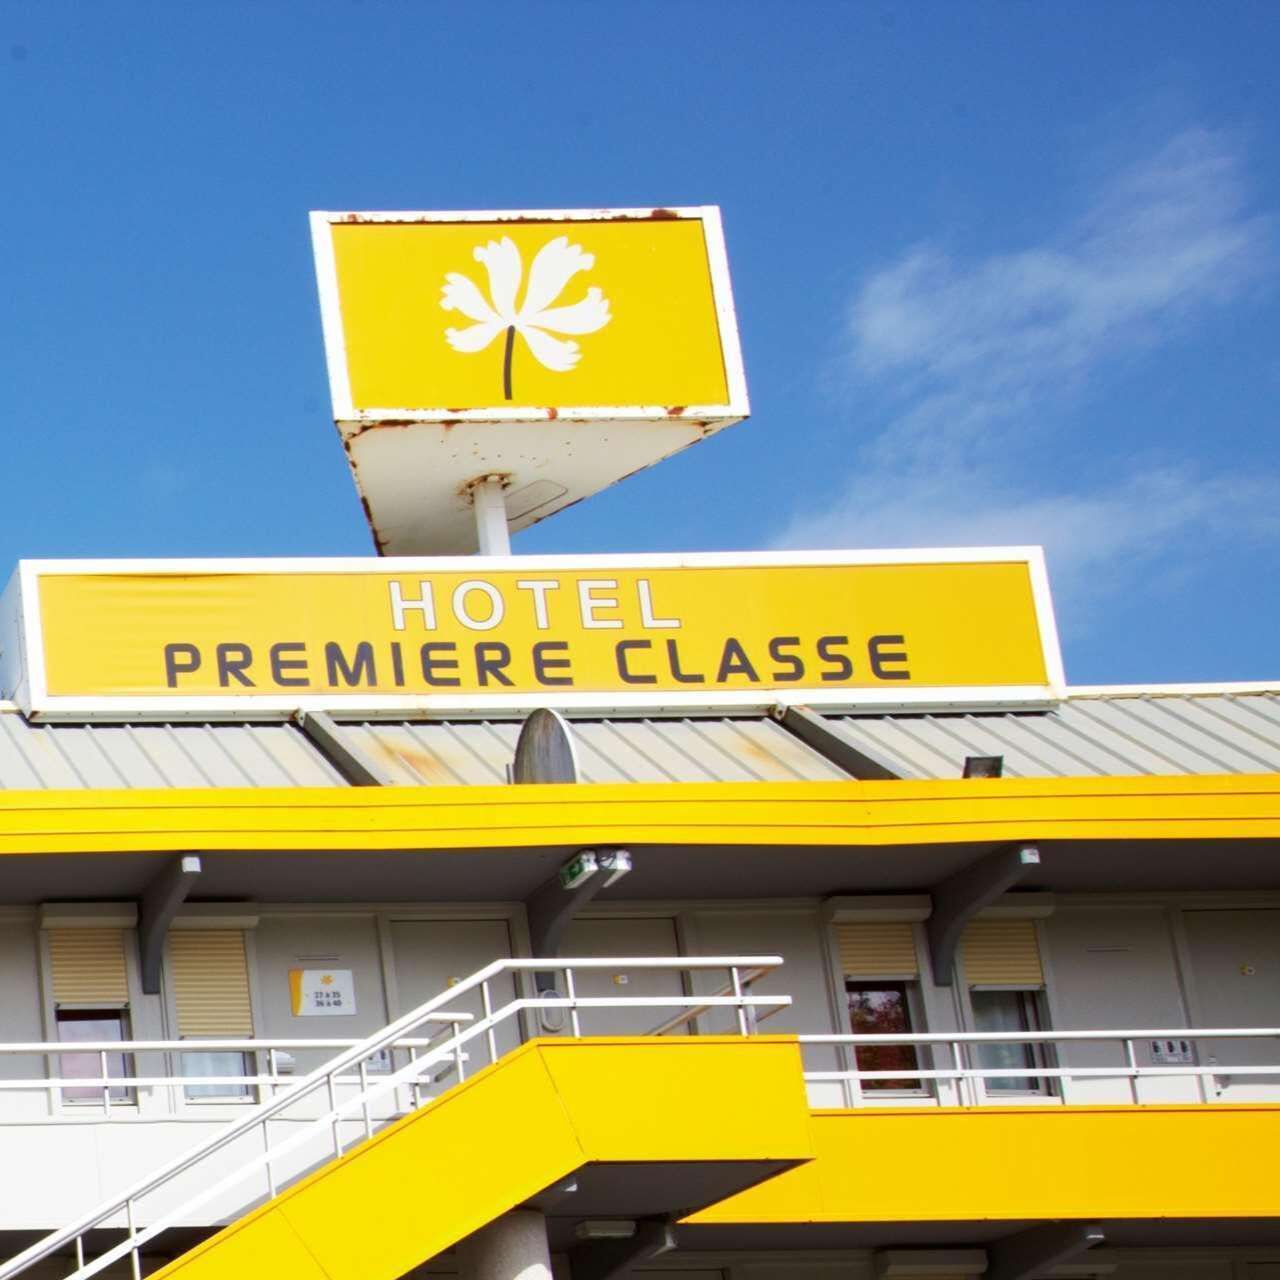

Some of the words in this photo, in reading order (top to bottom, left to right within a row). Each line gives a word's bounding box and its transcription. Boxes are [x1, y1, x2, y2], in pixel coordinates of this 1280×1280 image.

[389, 578, 681, 631] HOTEL
[163, 641, 575, 689] PREMIERE
[616, 634, 911, 685] CLASSE
